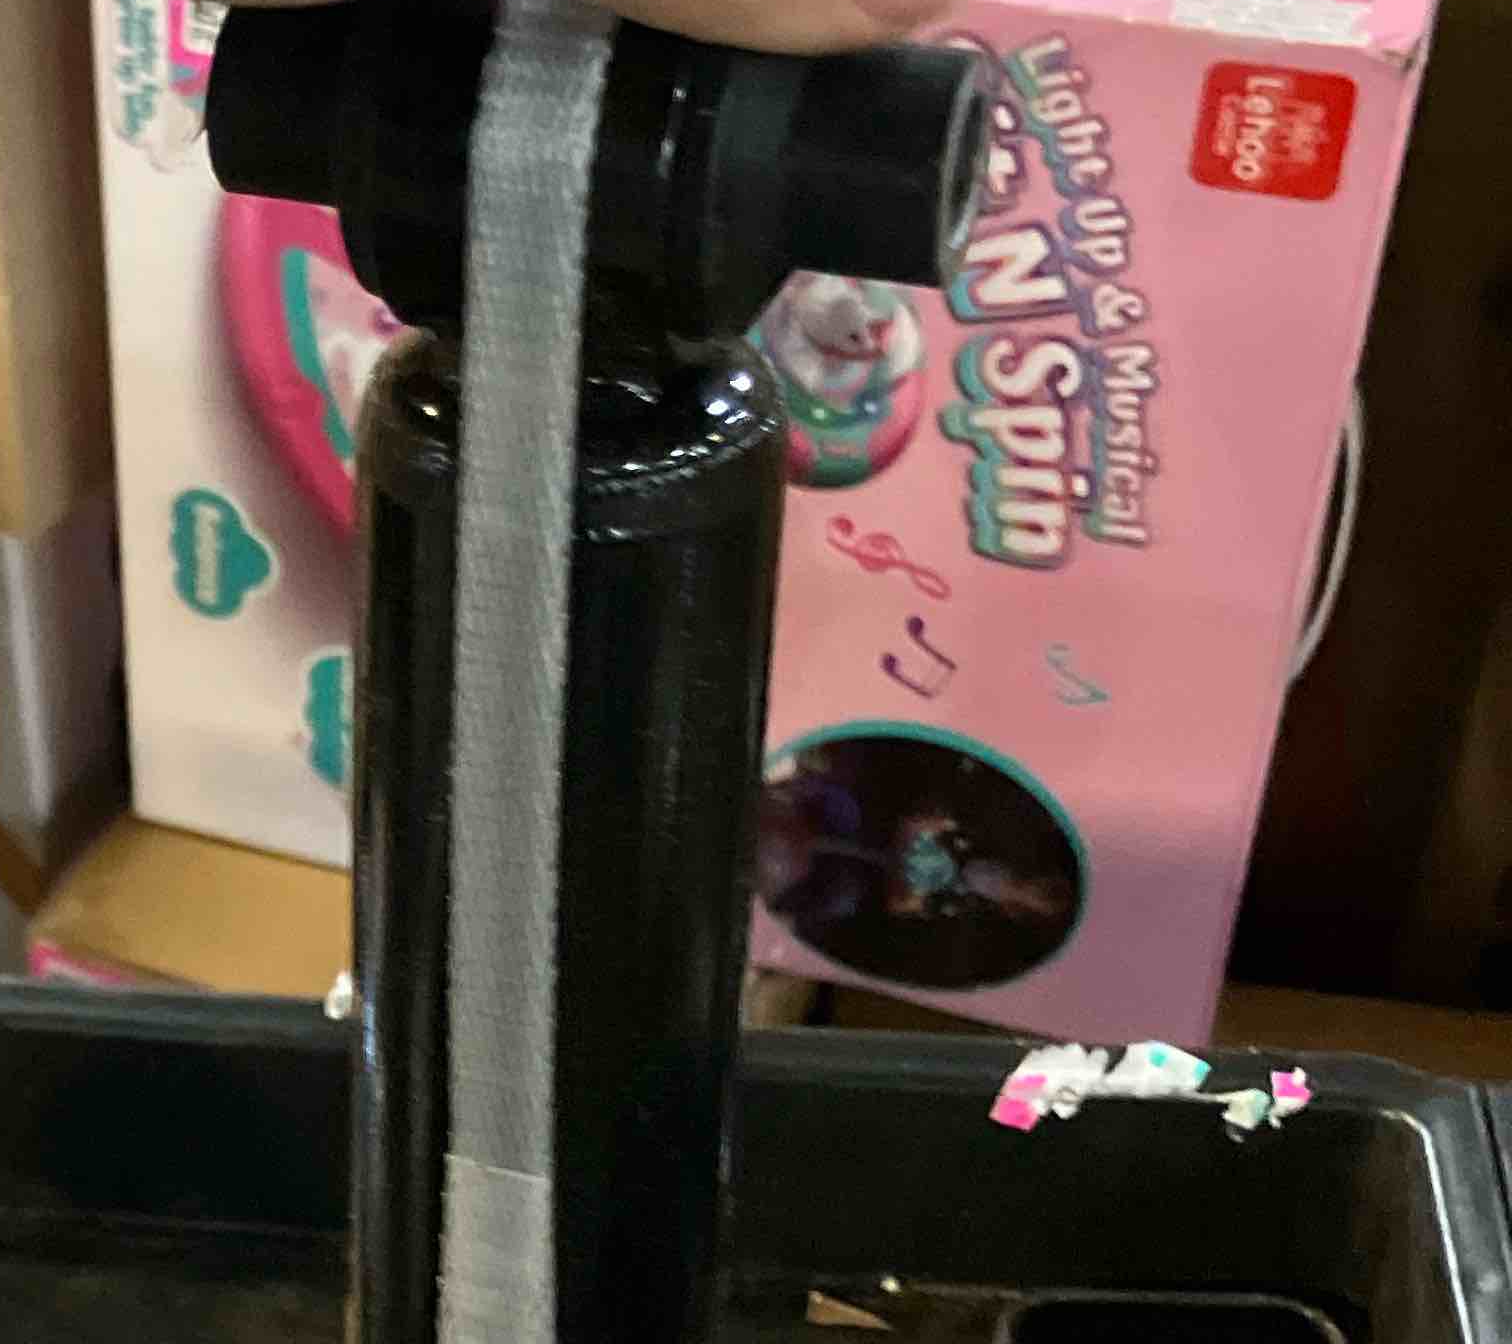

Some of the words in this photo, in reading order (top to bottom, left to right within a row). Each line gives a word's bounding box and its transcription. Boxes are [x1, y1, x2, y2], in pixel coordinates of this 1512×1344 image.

[1019, 36, 1115, 188] Light
[964, 226, 1068, 307] N
[1074, 198, 1132, 270] Up
[1092, 283, 1147, 333] &
[970, 338, 1090, 557] Spin
[1100, 343, 1158, 545] Musical
